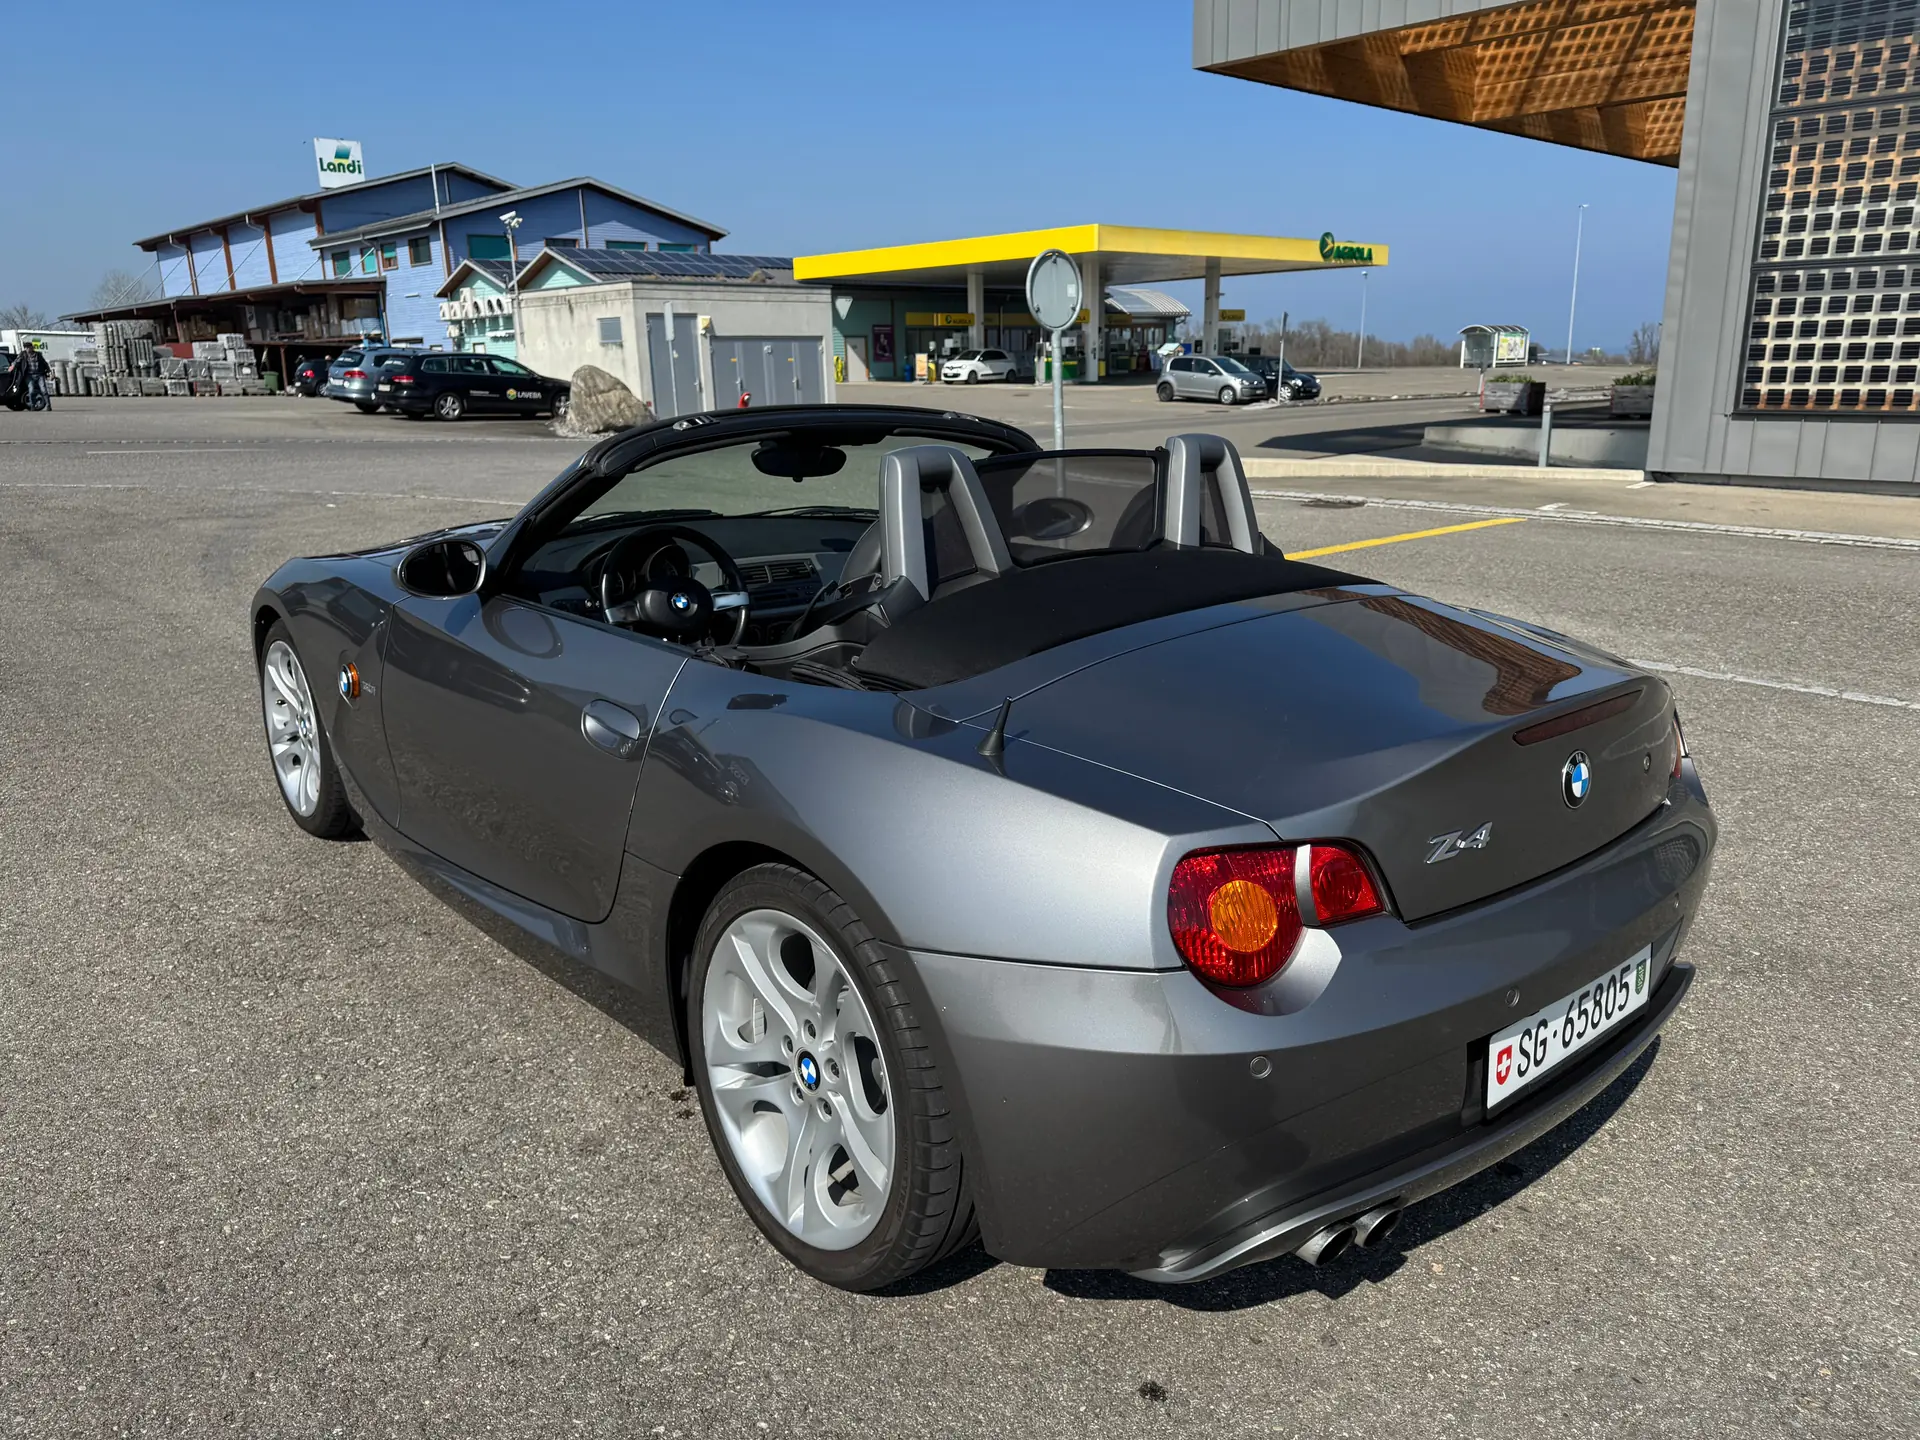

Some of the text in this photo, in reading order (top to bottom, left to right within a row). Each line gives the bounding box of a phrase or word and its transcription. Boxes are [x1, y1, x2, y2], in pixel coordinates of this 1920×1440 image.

[319, 157, 362, 174] Landi
[1333, 245, 1373, 261] AGROLA
[1424, 820, 1493, 864] Z4
